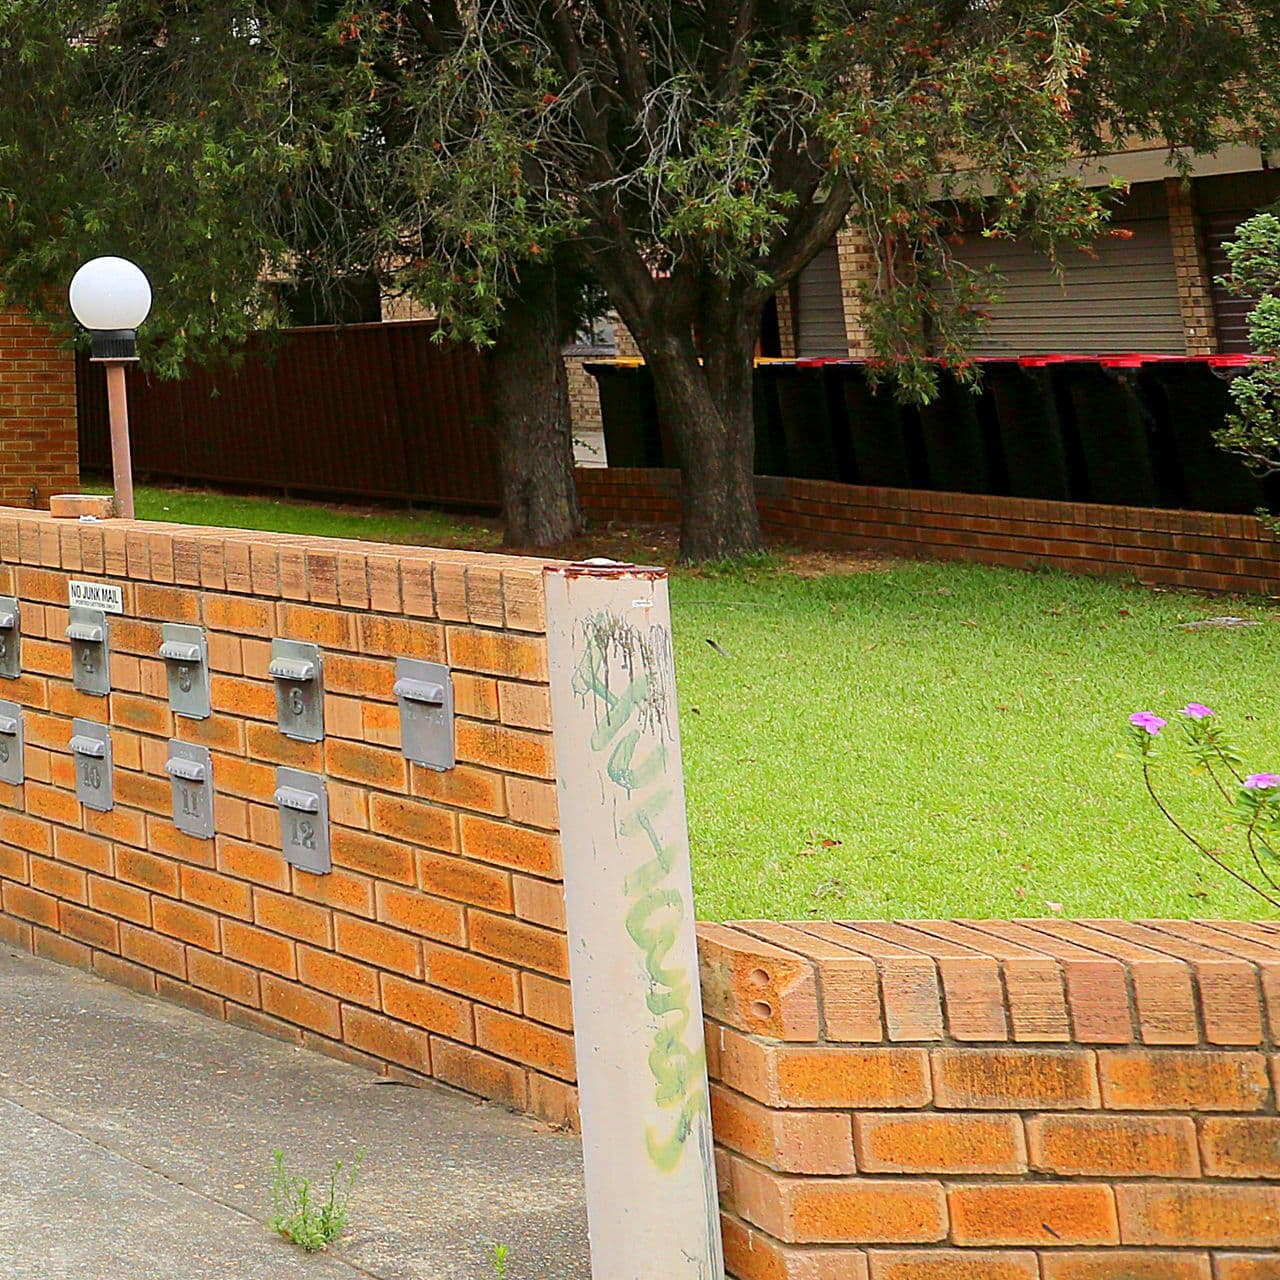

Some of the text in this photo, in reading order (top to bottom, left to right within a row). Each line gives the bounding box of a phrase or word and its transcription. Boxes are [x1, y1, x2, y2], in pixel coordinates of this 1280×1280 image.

[71, 583, 120, 604] NO JUNK MAIL
[178, 666, 192, 693] 5
[289, 687, 304, 716] 6
[80, 762, 102, 790] 10
[182, 784, 202, 819] 11
[290, 817, 317, 851] 12
